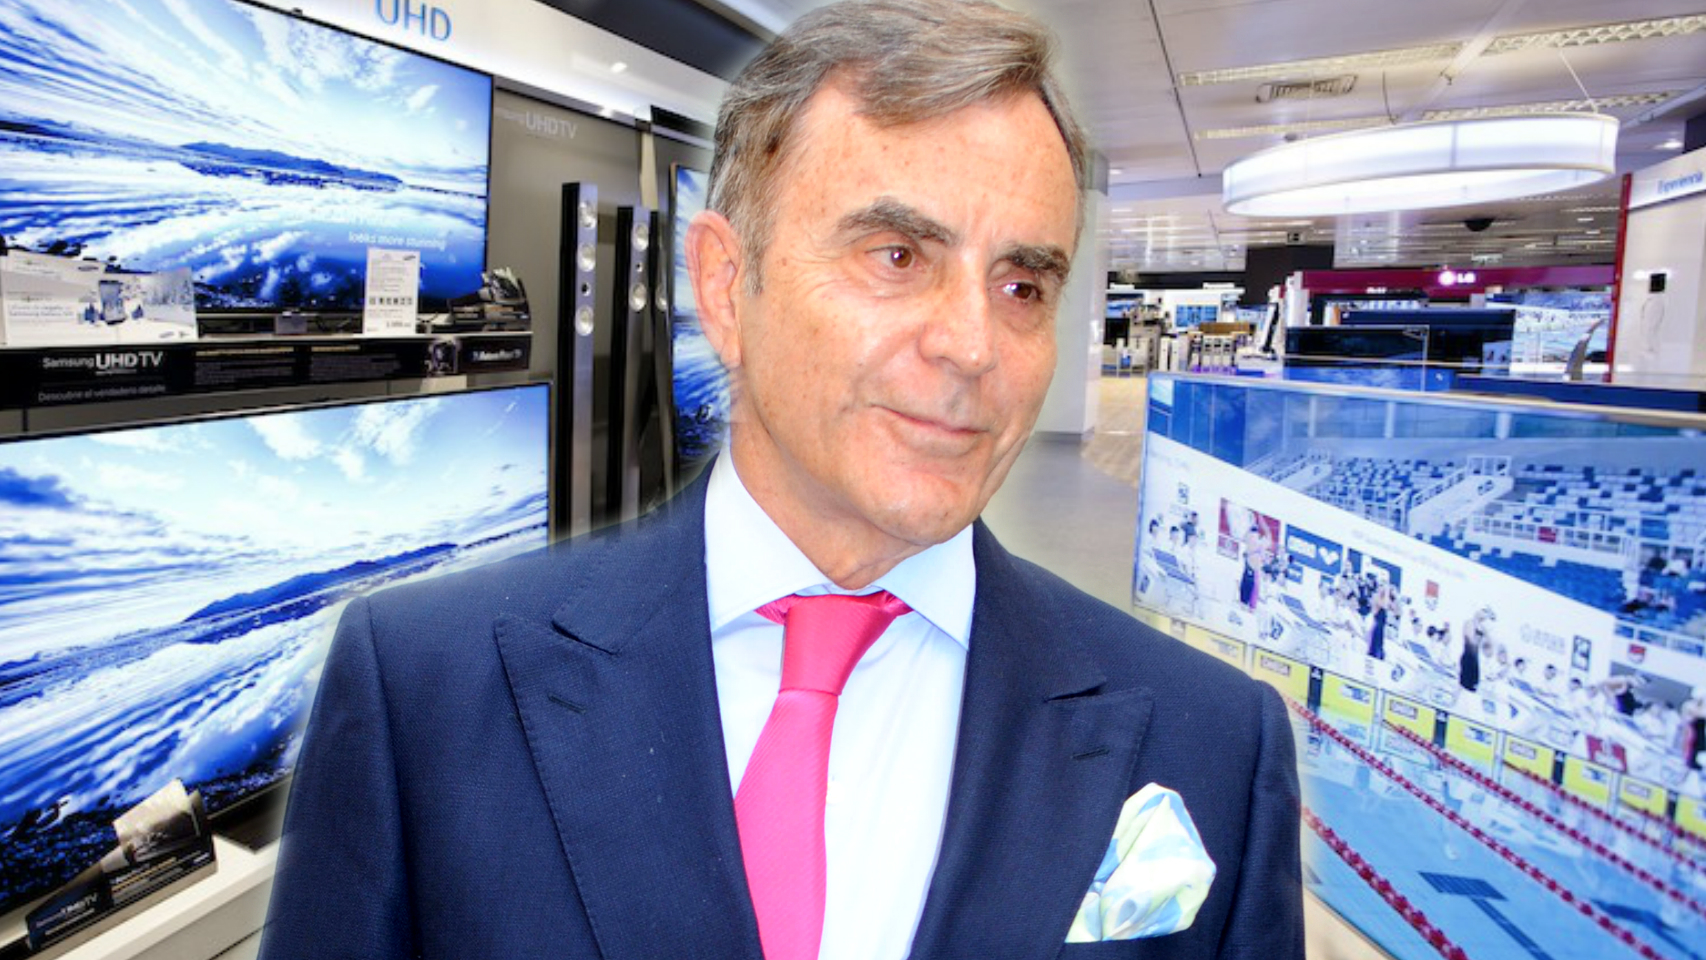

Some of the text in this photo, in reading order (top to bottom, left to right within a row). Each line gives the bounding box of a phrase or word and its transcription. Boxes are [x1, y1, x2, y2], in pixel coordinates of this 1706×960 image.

[375, 0, 452, 41] UHD
[1457, 272, 1476, 284] LG
[43, 356, 95, 369] Samsung
